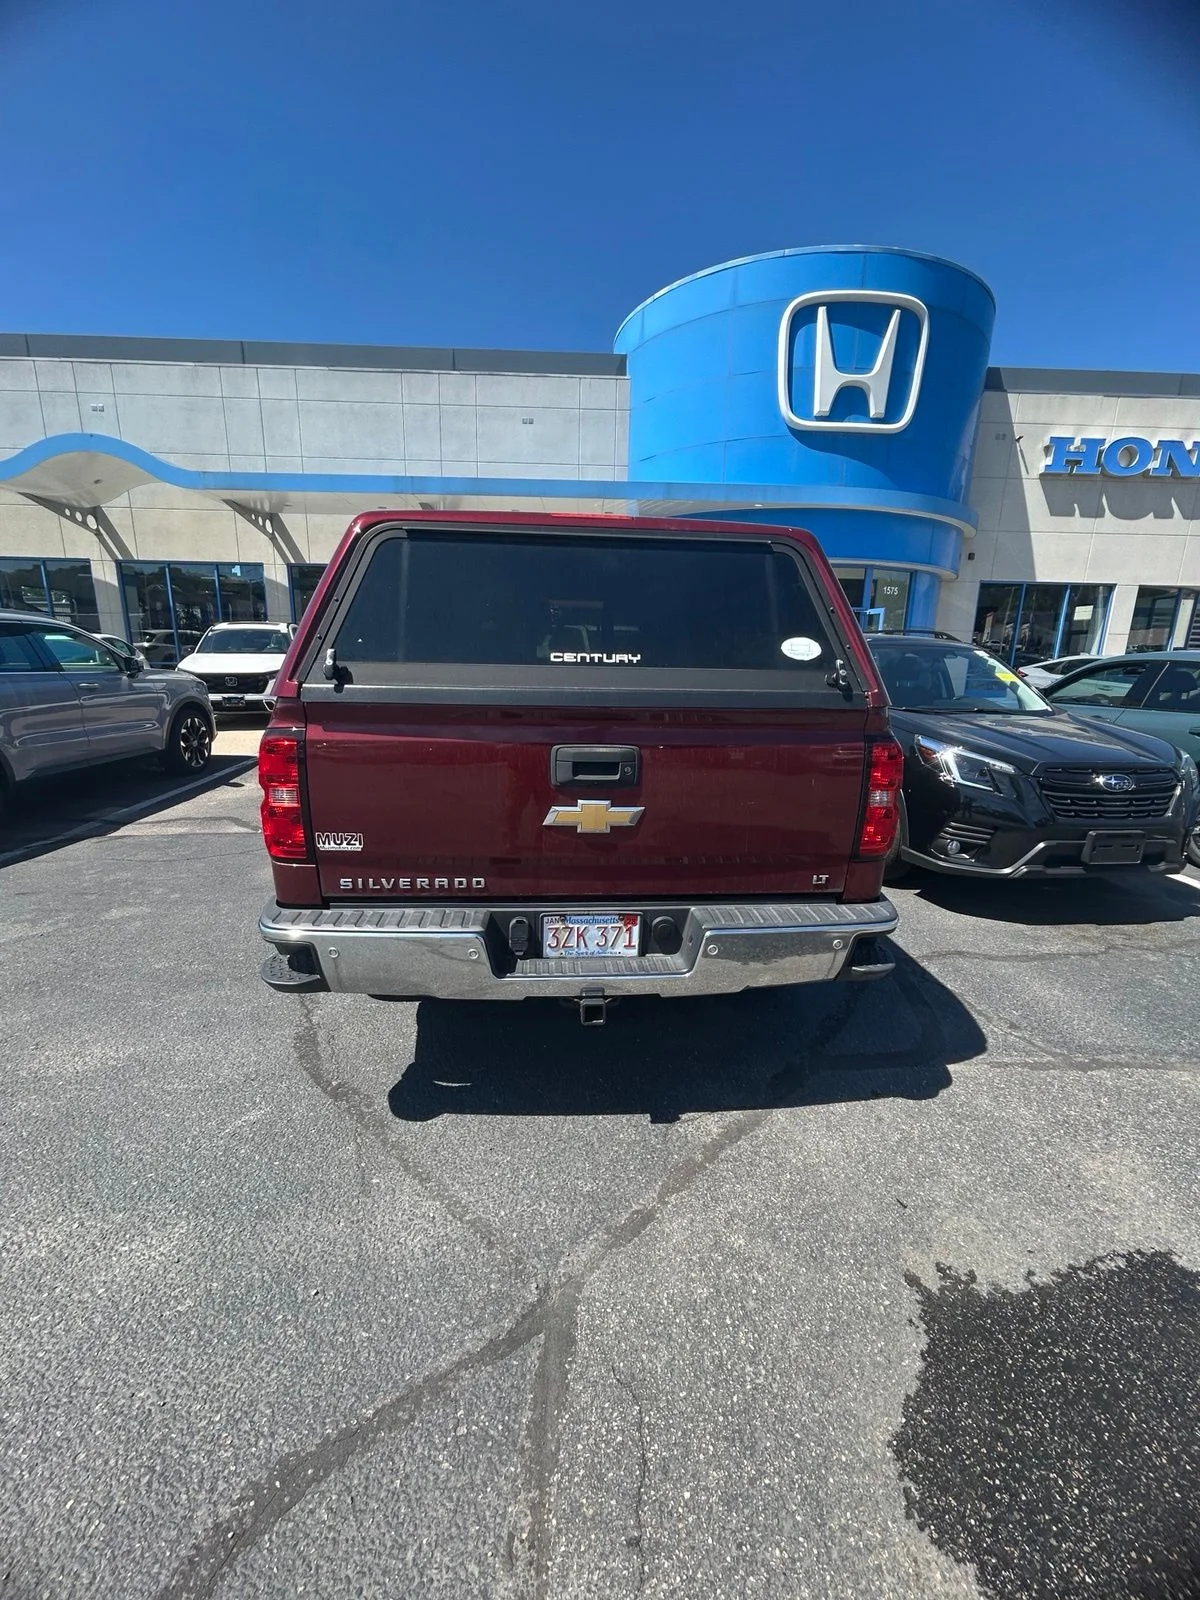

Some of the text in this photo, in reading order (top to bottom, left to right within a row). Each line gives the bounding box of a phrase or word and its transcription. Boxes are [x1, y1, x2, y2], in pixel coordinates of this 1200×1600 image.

[1043, 436, 1200, 477] HON
[883, 586, 899, 595] 1575
[550, 652, 641, 664] CENTURY
[315, 832, 364, 846] MUZI
[339, 878, 486, 889] SILVERADO
[812, 874, 830, 885] LT
[565, 915, 619, 925] Massachusetts
[547, 925, 637, 949] 3ZK 371
